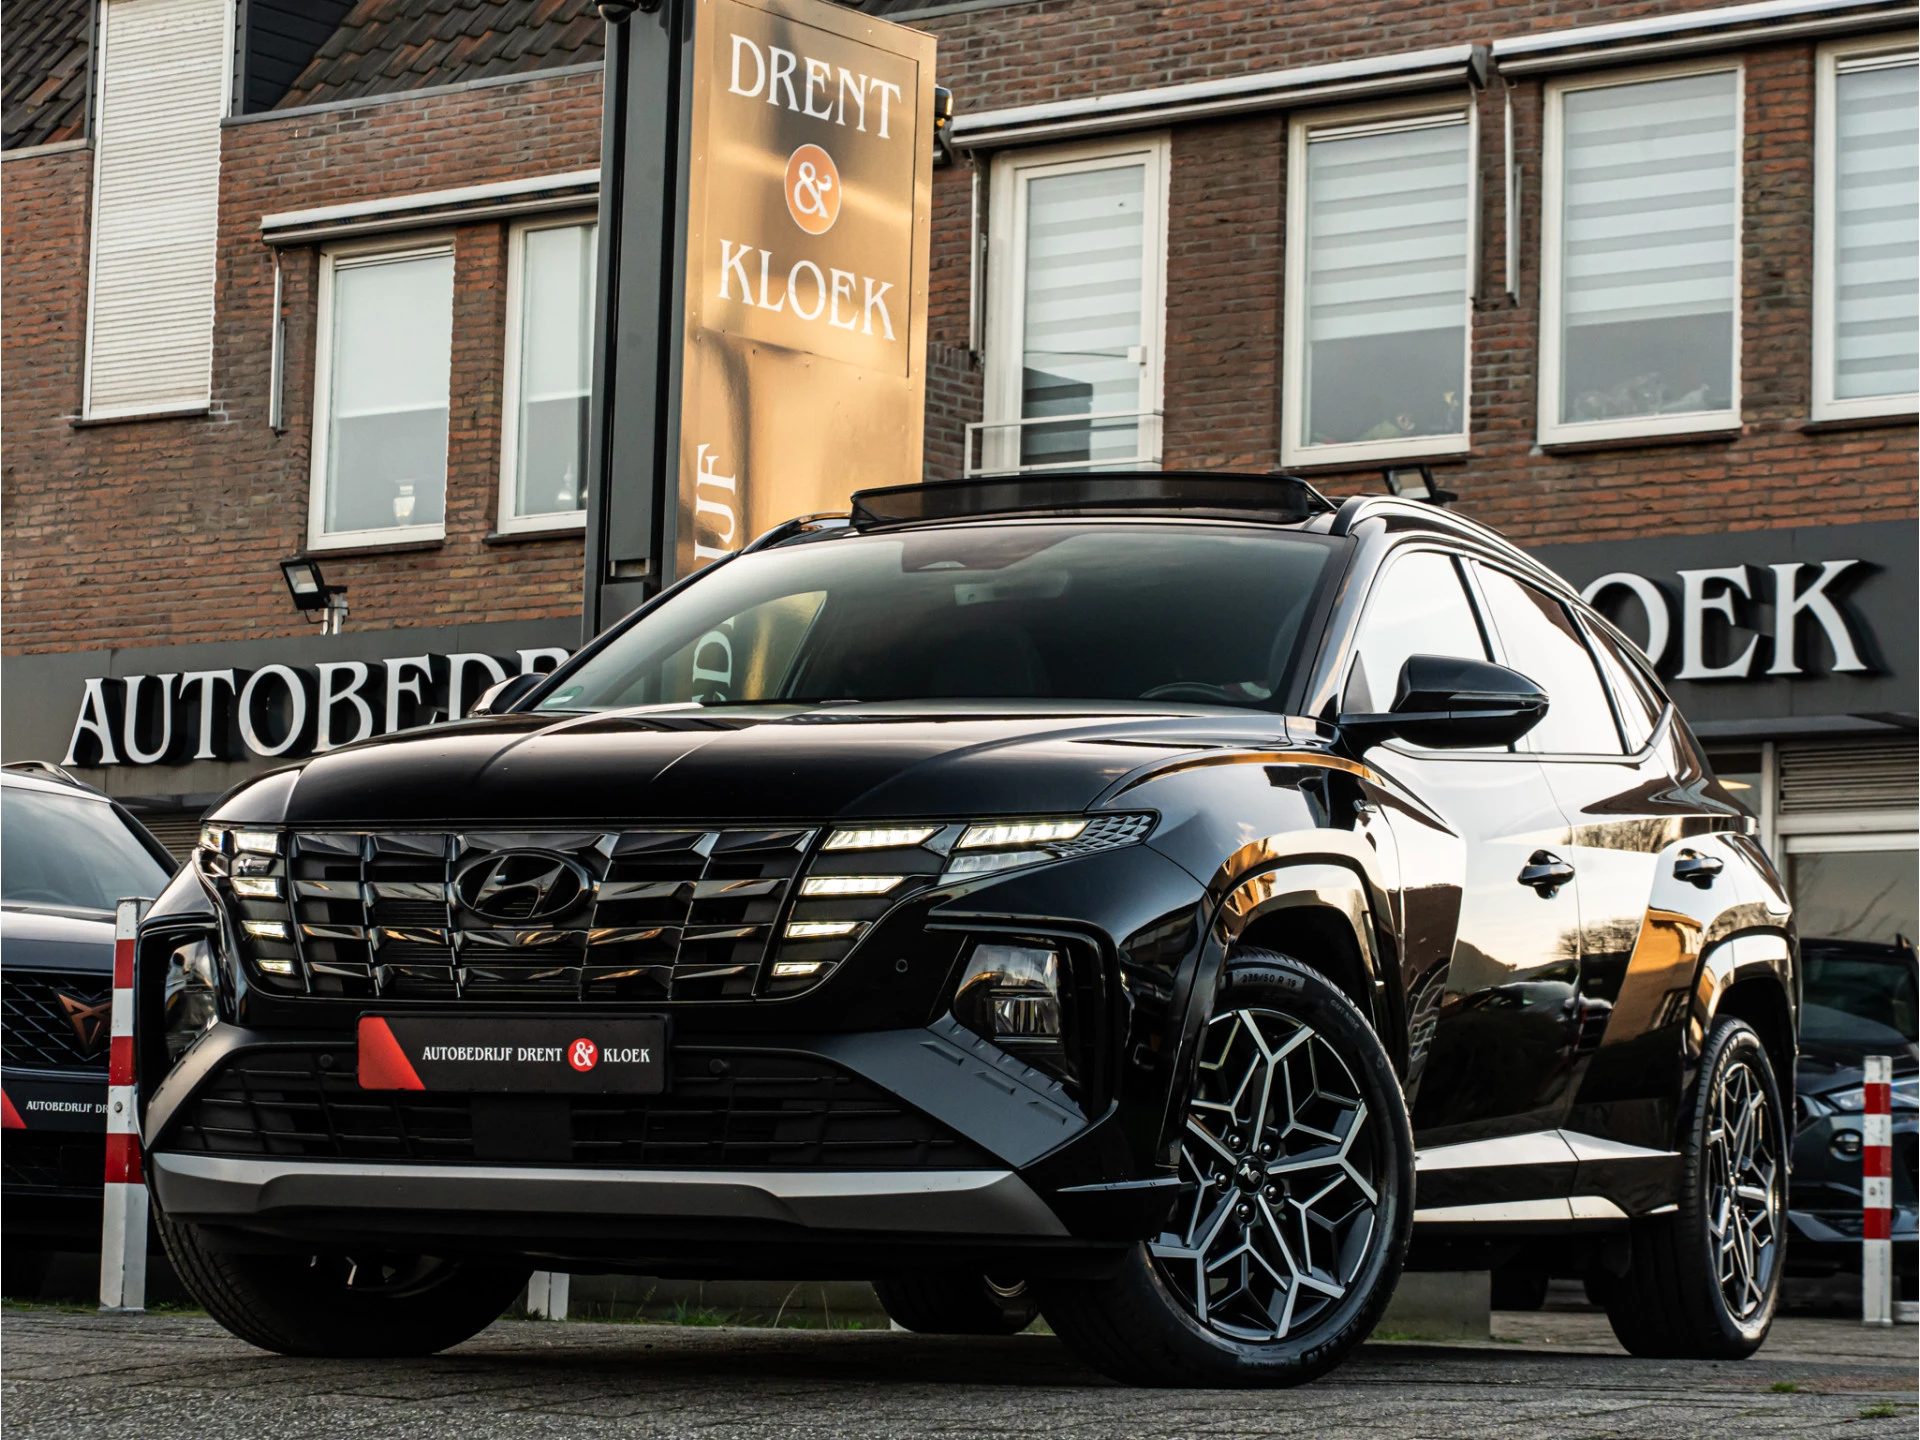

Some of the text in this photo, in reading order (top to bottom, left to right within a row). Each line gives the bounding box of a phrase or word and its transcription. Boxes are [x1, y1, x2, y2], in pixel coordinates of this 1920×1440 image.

[728, 33, 901, 139] DRENT
[793, 161, 832, 219] &
[717, 239, 896, 341] KLOEK
[422, 1041, 650, 1066] AUTOBEDRIJF DRENT & KLOEK
[26, 1100, 93, 1113] AUTOBEDRIJF
